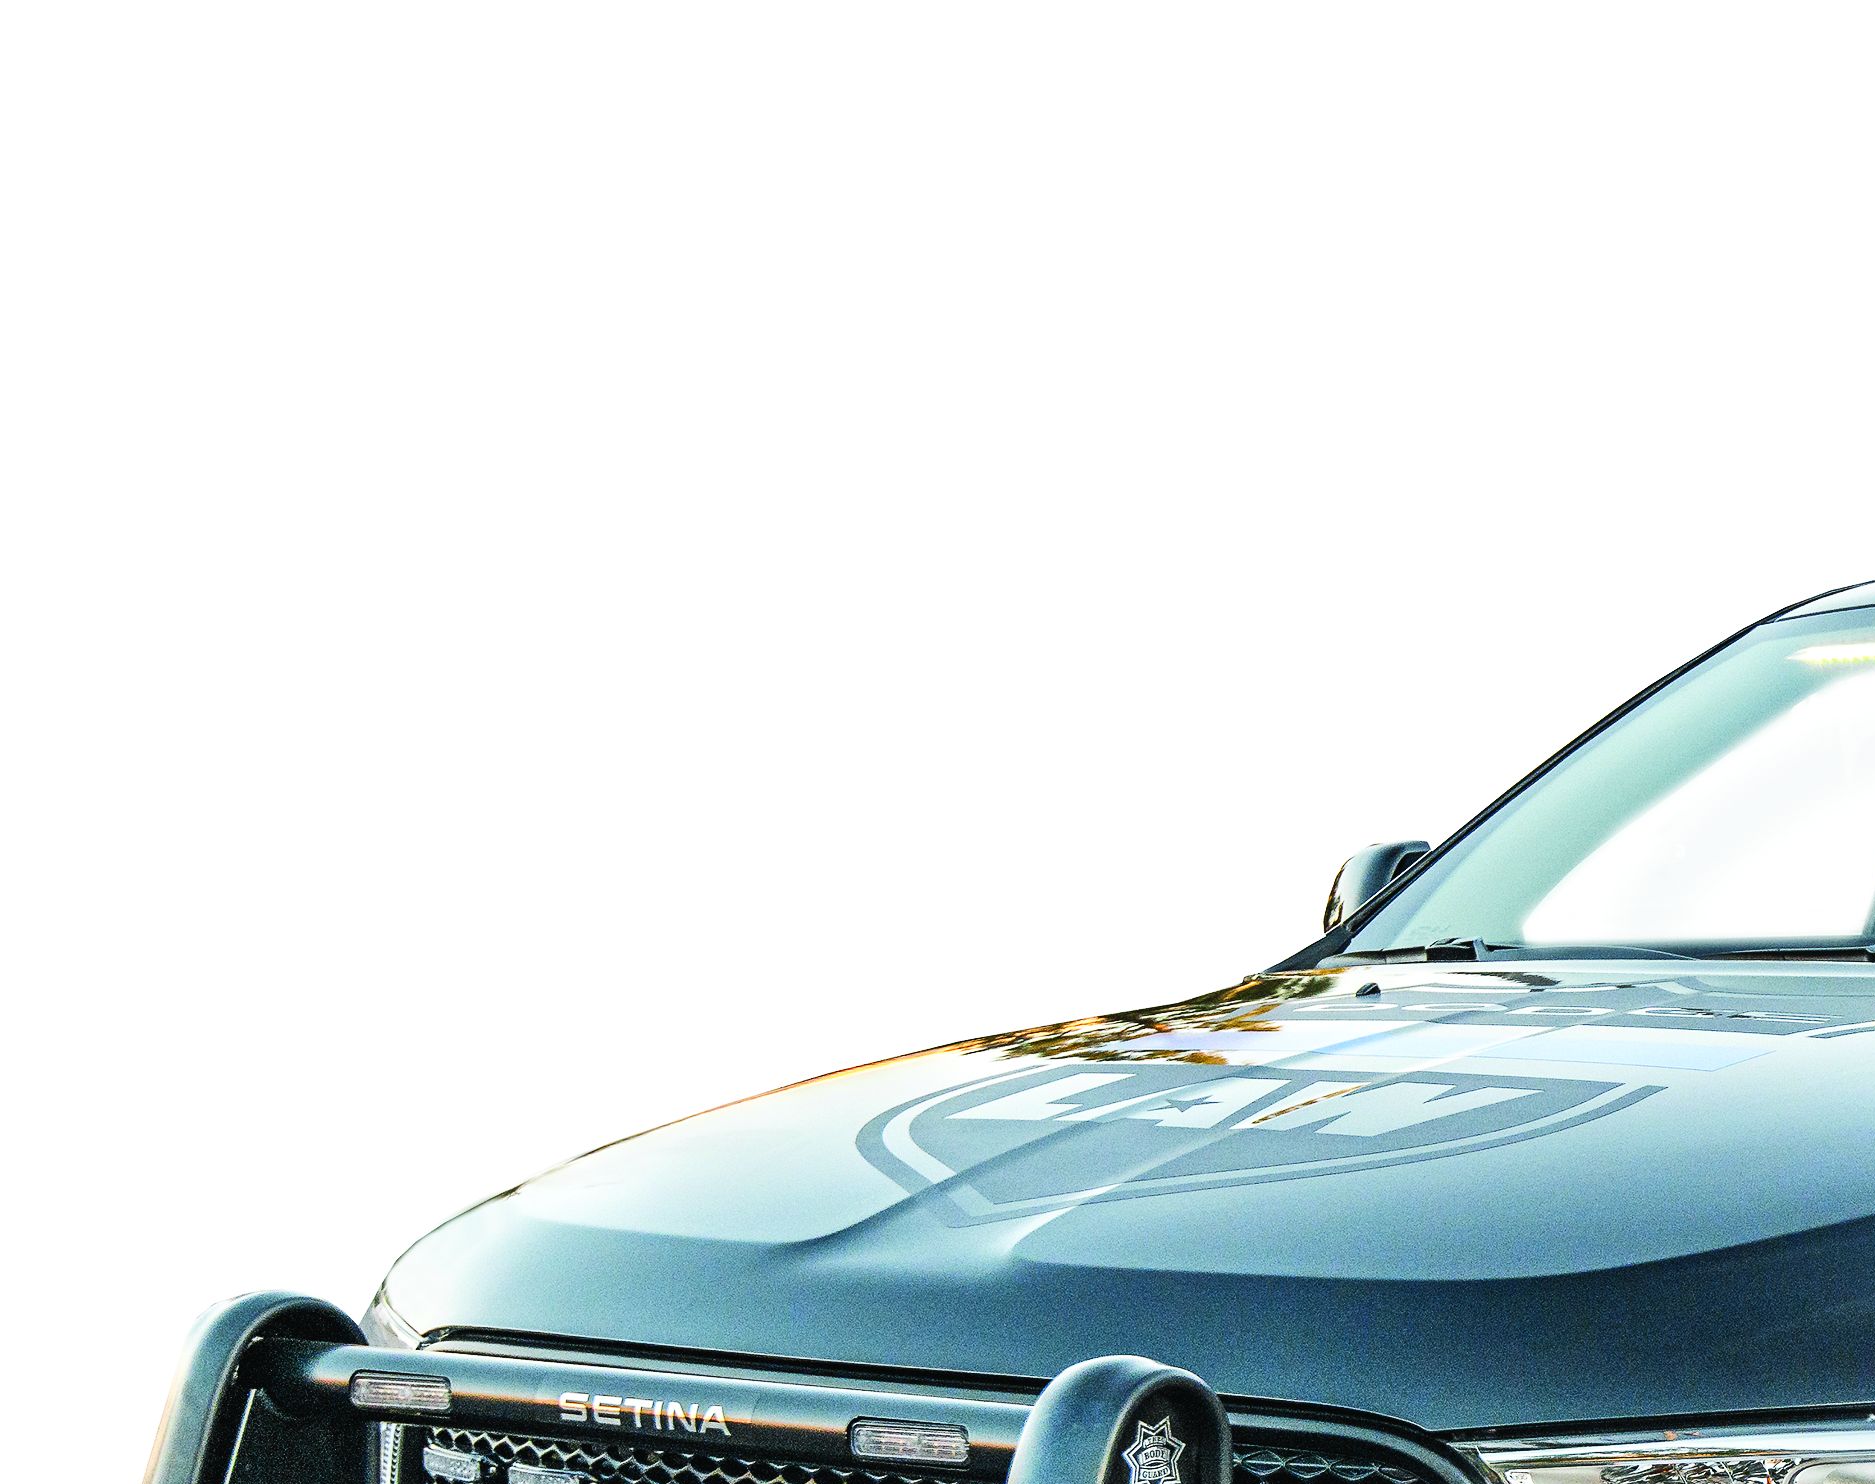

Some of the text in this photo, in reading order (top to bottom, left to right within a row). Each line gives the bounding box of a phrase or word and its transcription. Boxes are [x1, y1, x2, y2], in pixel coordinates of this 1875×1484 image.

[1292, 1002, 1844, 1023] DODGE
[948, 1071, 1548, 1137] LAW
[558, 1391, 732, 1437] SETINA
